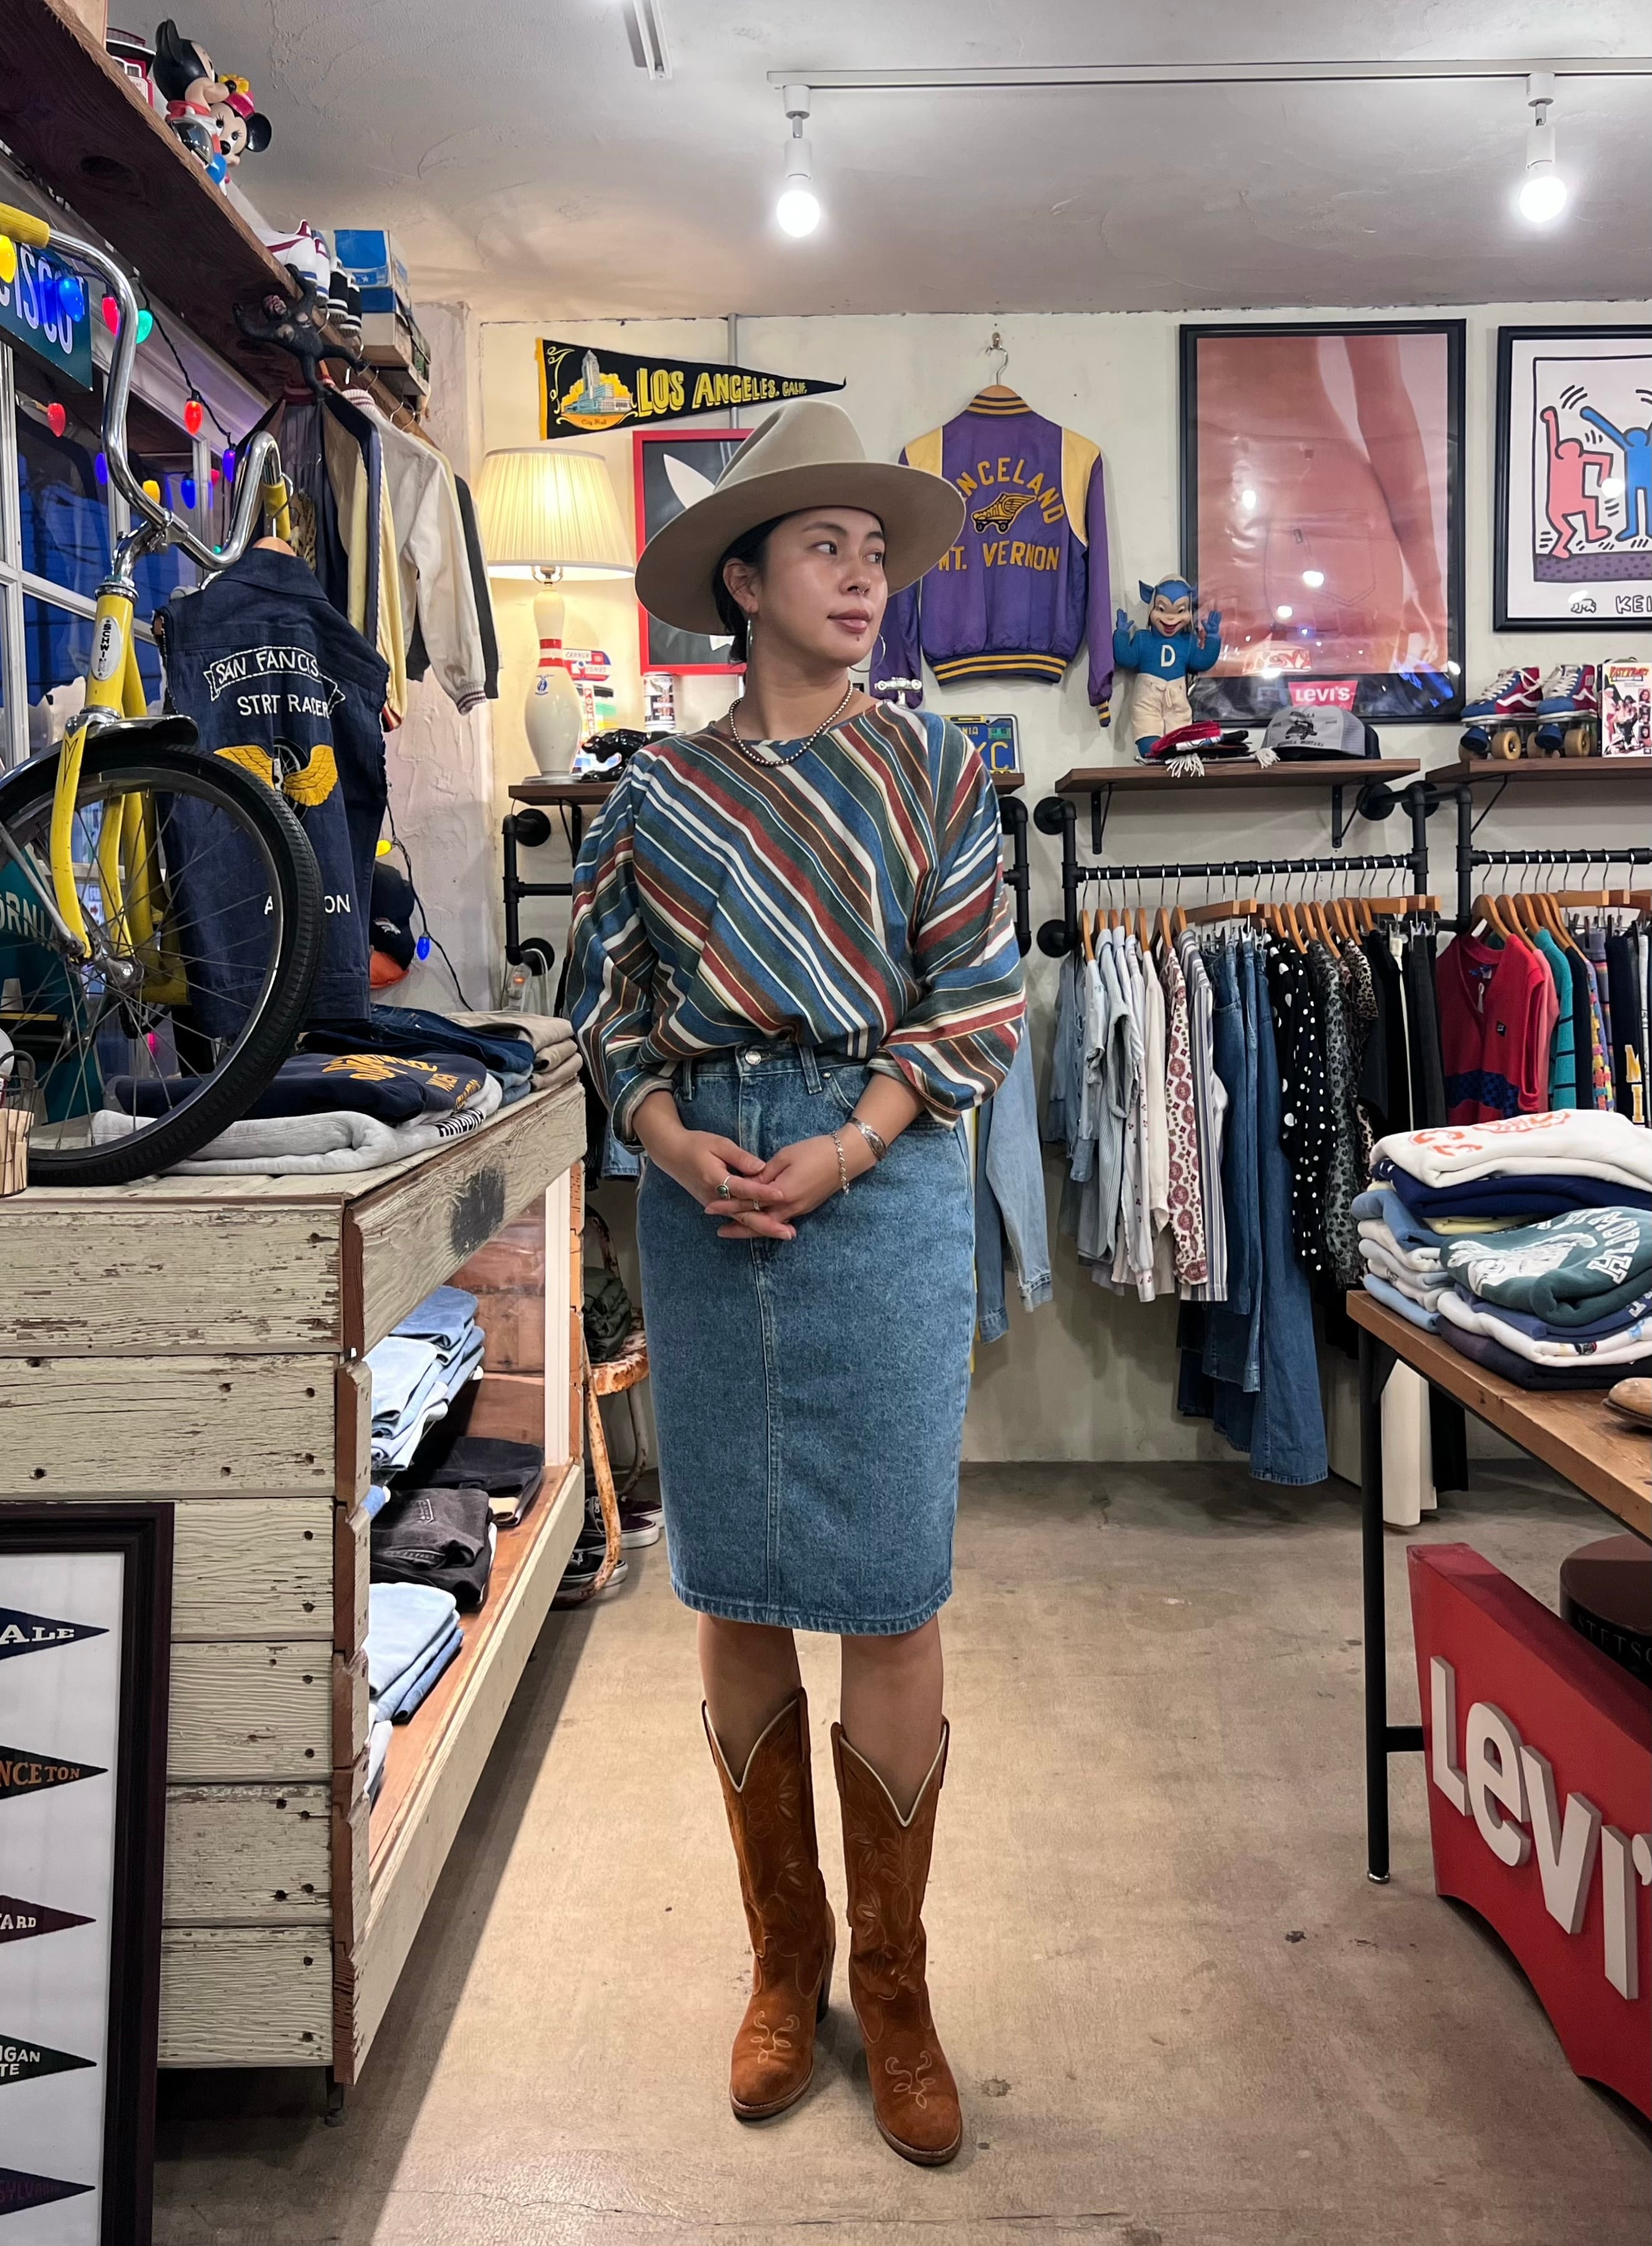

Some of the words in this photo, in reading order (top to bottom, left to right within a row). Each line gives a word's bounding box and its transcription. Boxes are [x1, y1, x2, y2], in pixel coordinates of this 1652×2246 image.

[0, 242, 73, 355] ISCO
[637, 367, 685, 418] LOS
[956, 458, 1065, 524] NCELAND
[982, 541, 1060, 571] VERNON
[1161, 645, 1176, 667] D
[216, 657, 246, 685] SAN
[237, 694, 281, 717] STRT
[0, 1624, 75, 1645] ALE
[0, 1913, 37, 1930] ARD
